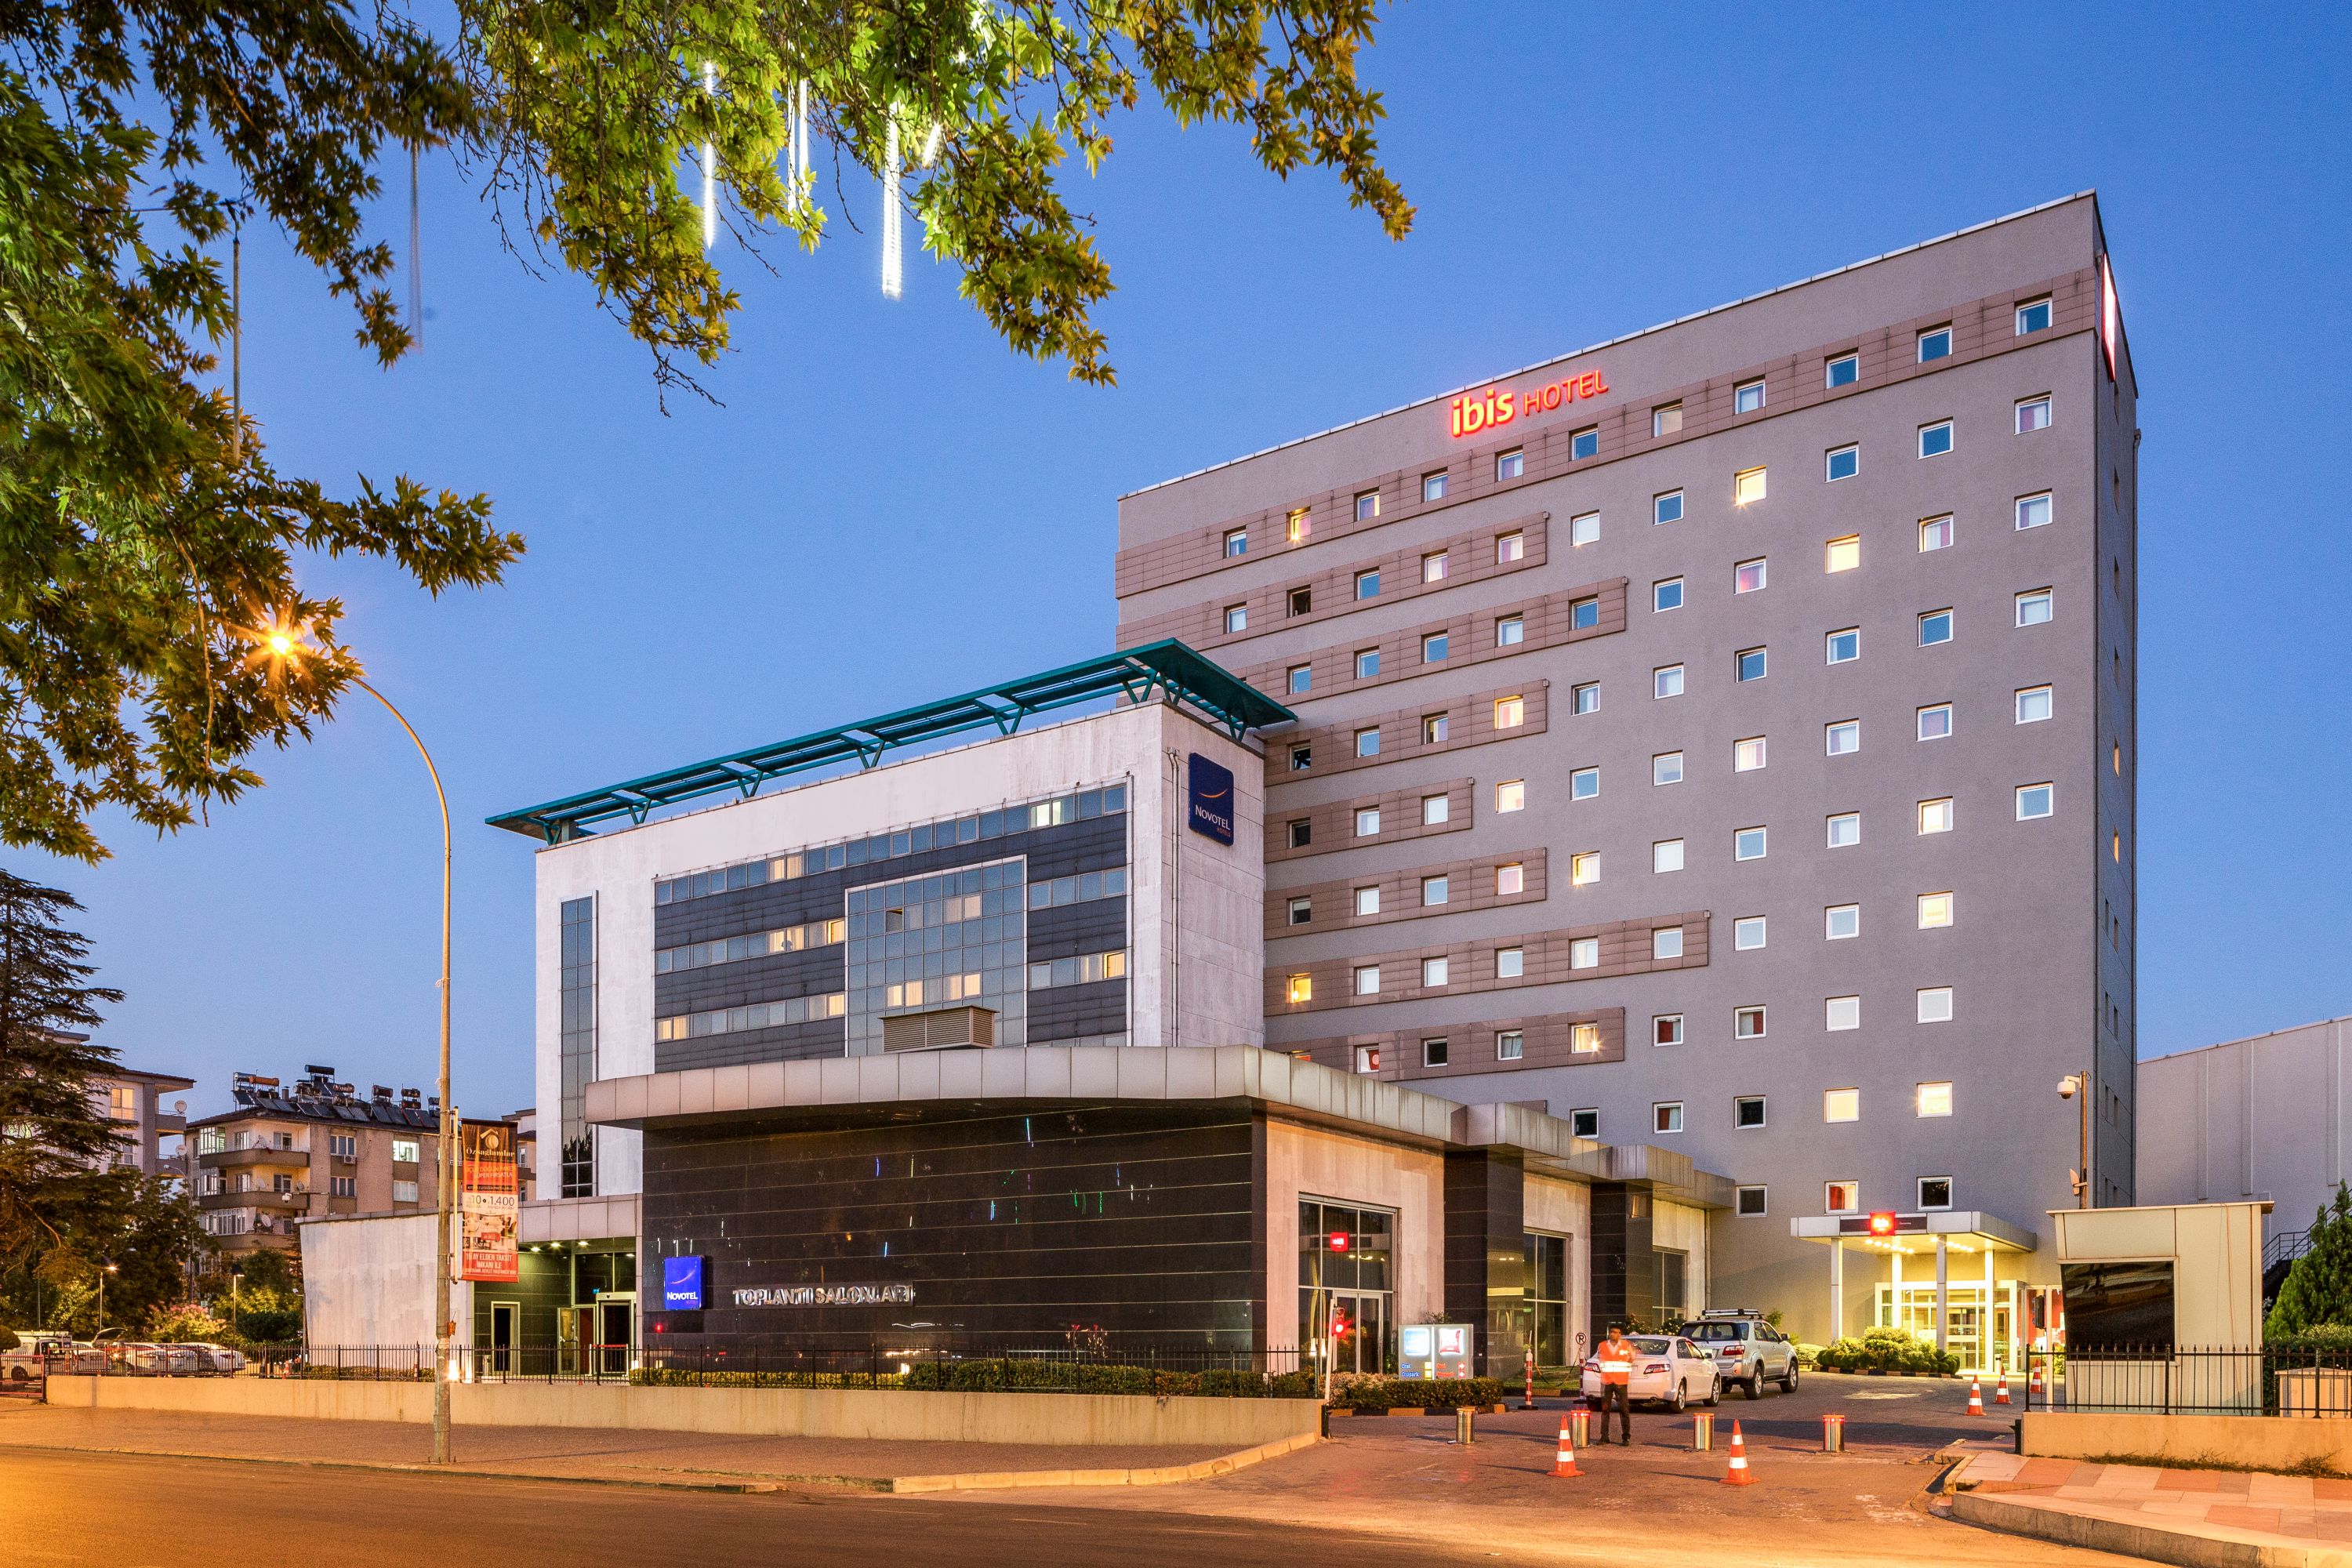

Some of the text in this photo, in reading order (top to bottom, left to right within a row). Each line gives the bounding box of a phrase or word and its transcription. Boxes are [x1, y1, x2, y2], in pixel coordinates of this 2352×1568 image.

[1452, 369, 1609, 437] ibis HOTEL
[1195, 804, 1231, 831] NOVOTEL
[666, 1291, 699, 1301] NOVOTEL
[732, 1286, 913, 1306] TOPLANTI SALONLARI
